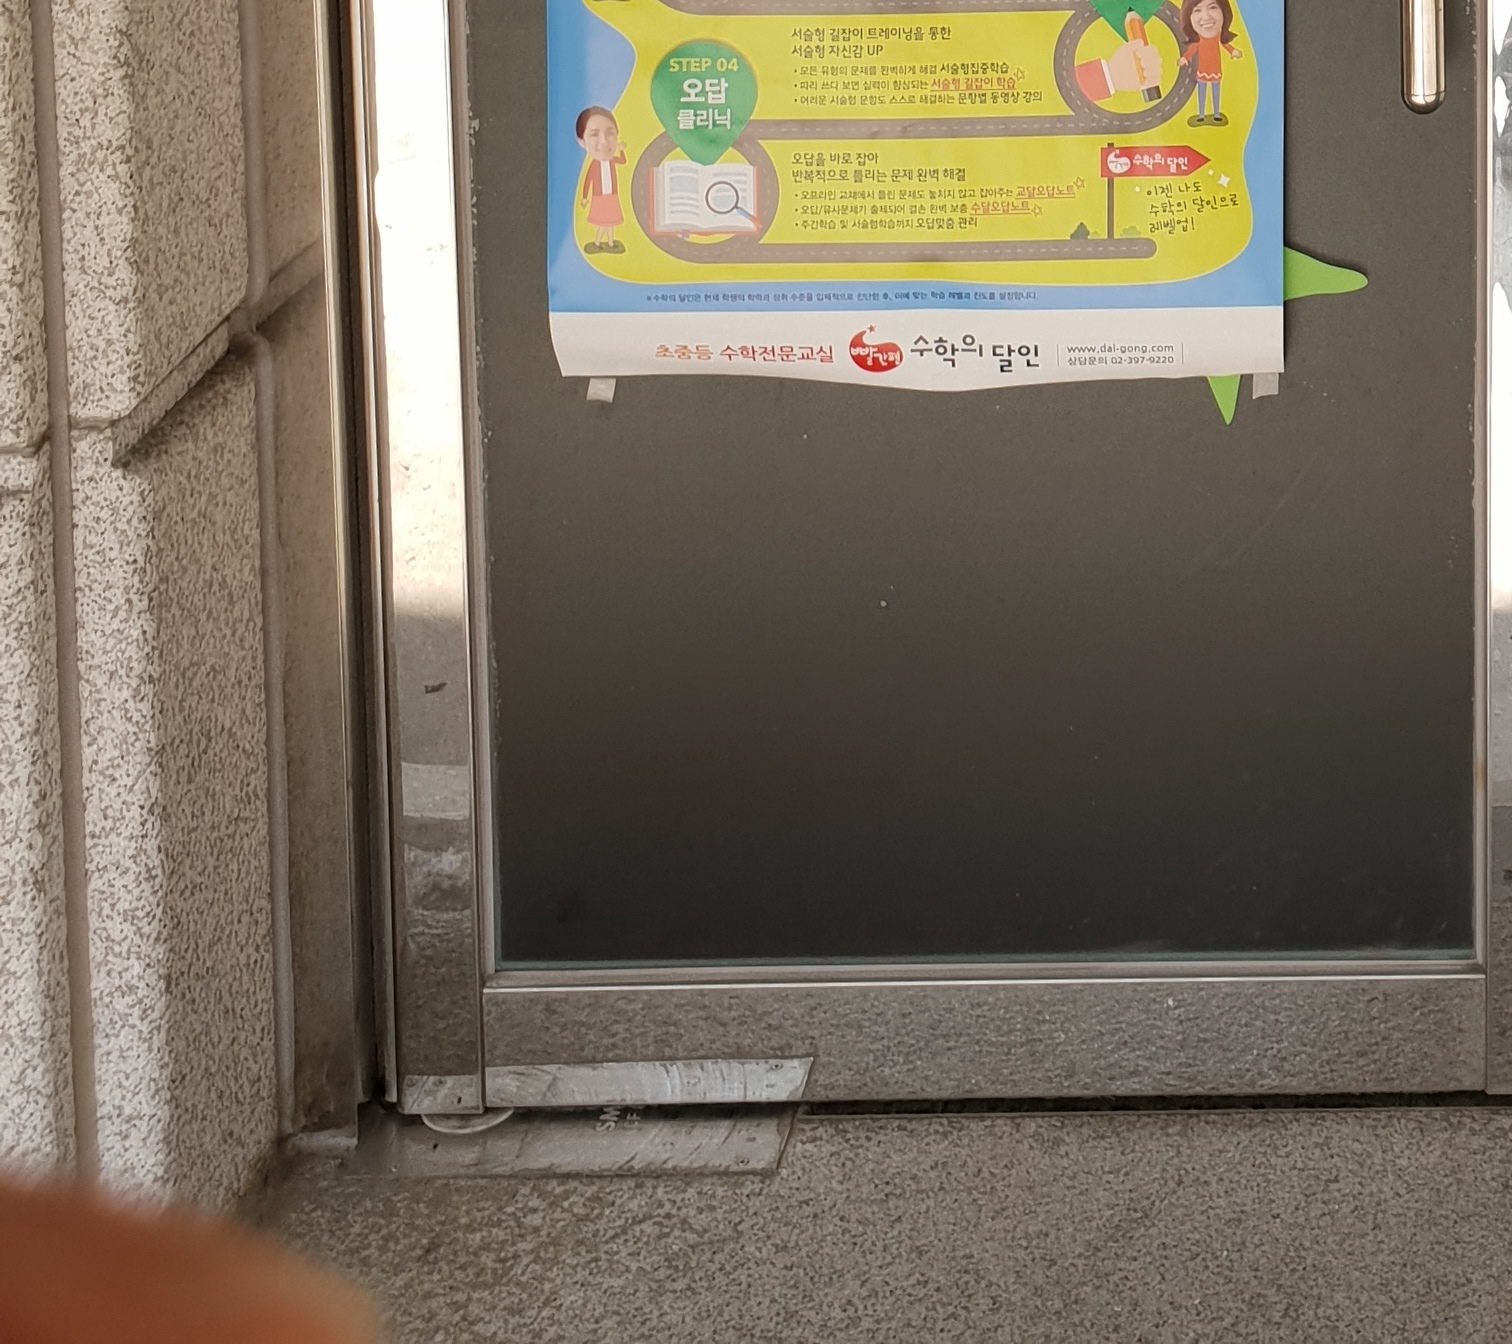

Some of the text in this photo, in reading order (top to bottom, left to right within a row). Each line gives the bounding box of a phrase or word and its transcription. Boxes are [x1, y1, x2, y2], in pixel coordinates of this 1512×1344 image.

[791, 25, 952, 42] 서술형 길잡이 트레이닝을 통한
[791, 44, 884, 59] 서술형 자신감 UP
[669, 57, 739, 72] STEP 04
[679, 77, 729, 105] 오답
[676, 108, 732, 130] 클리닉
[791, 150, 879, 166] 오답을 바로 잡아
[1132, 152, 1165, 170] 수학의
[1167, 156, 1189, 173] 달인
[791, 167, 967, 184] 반복적으로 틀리는 문제 완벽 해결
[1146, 181, 1203, 198] 이젠 나도
[1149, 193, 1240, 218] 수학의 달인으로
[1148, 216, 1196, 235] 레벨업!
[654, 344, 836, 364] 초중등 수학전문교실
[850, 346, 902, 367] 빨간펜
[910, 334, 1040, 373] 수학의 달인
[1066, 342, 1175, 355] www.dal-gong.com
[1067, 354, 1175, 367] 상담문의 02-397-9220
